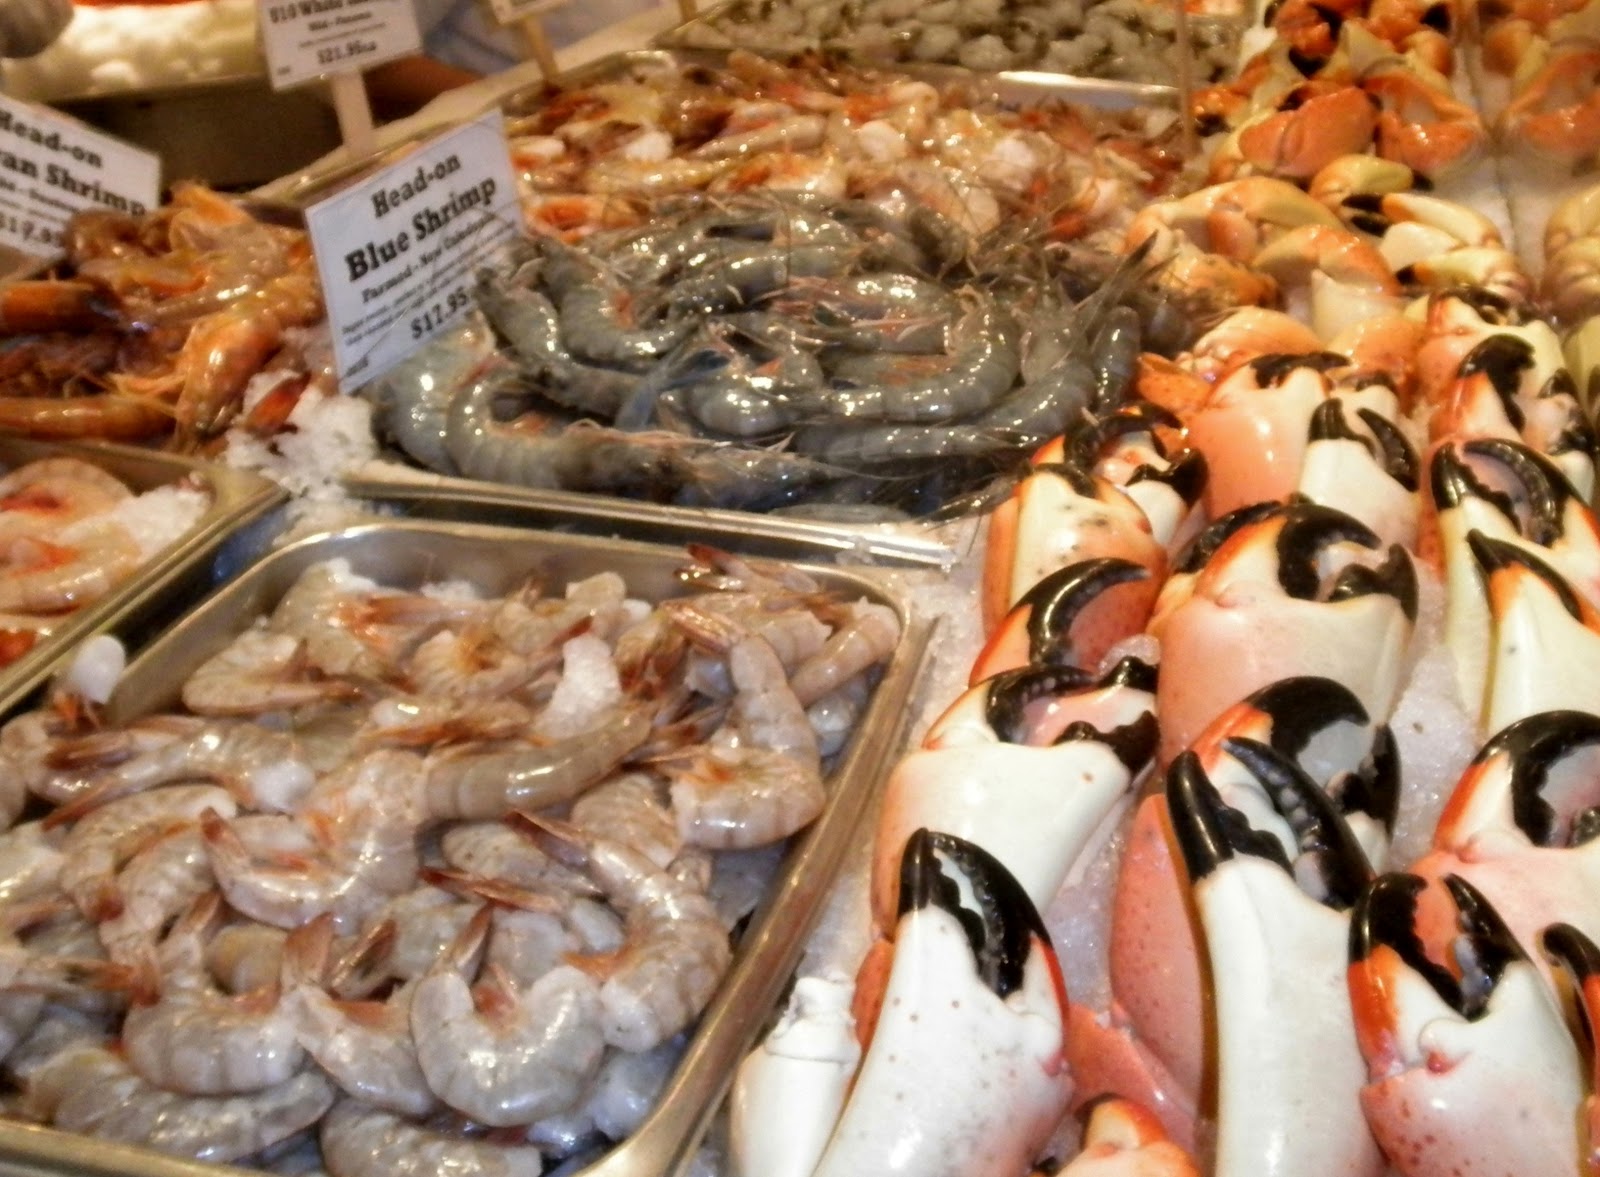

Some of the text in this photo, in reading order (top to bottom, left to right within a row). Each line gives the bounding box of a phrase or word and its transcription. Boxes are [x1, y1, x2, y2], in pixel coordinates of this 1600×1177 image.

[46, 163, 146, 217] Shrimp
[370, 154, 462, 219] Head-on
[344, 231, 410, 282] Blue
[411, 177, 497, 242] Shrimp
[361, 265, 413, 303] Farmed
